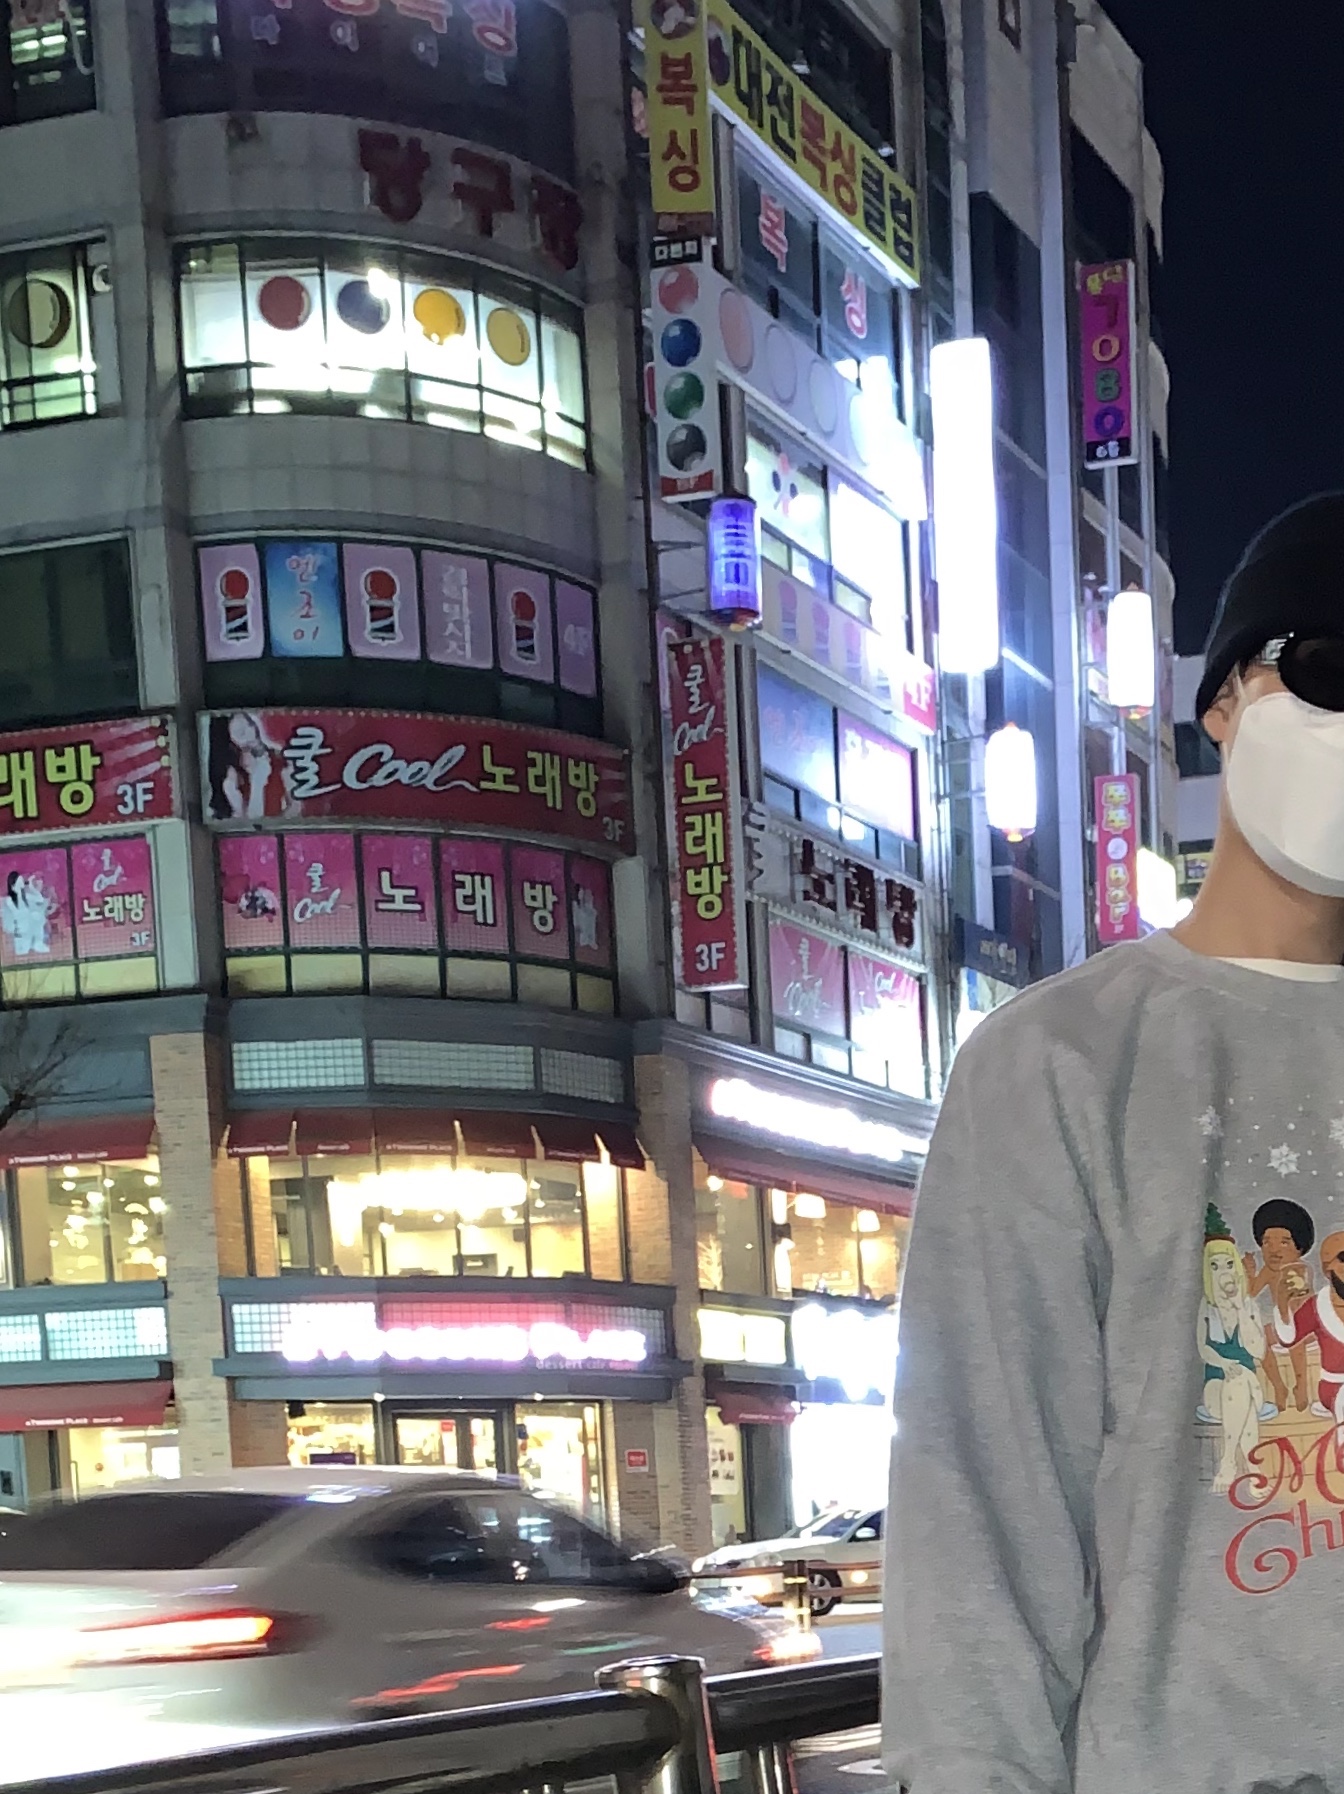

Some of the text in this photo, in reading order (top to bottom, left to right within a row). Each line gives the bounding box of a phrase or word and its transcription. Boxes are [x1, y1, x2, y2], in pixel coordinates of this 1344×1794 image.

[117, 782, 154, 815] 3F
[343, 743, 480, 793] Cool
[479, 743, 599, 818] 노래방
[602, 816, 626, 842] 3F
[681, 762, 729, 921] 노래방
[83, 894, 147, 923] 노래방
[131, 931, 151, 946] 3F
[695, 942, 727, 973] 3F
